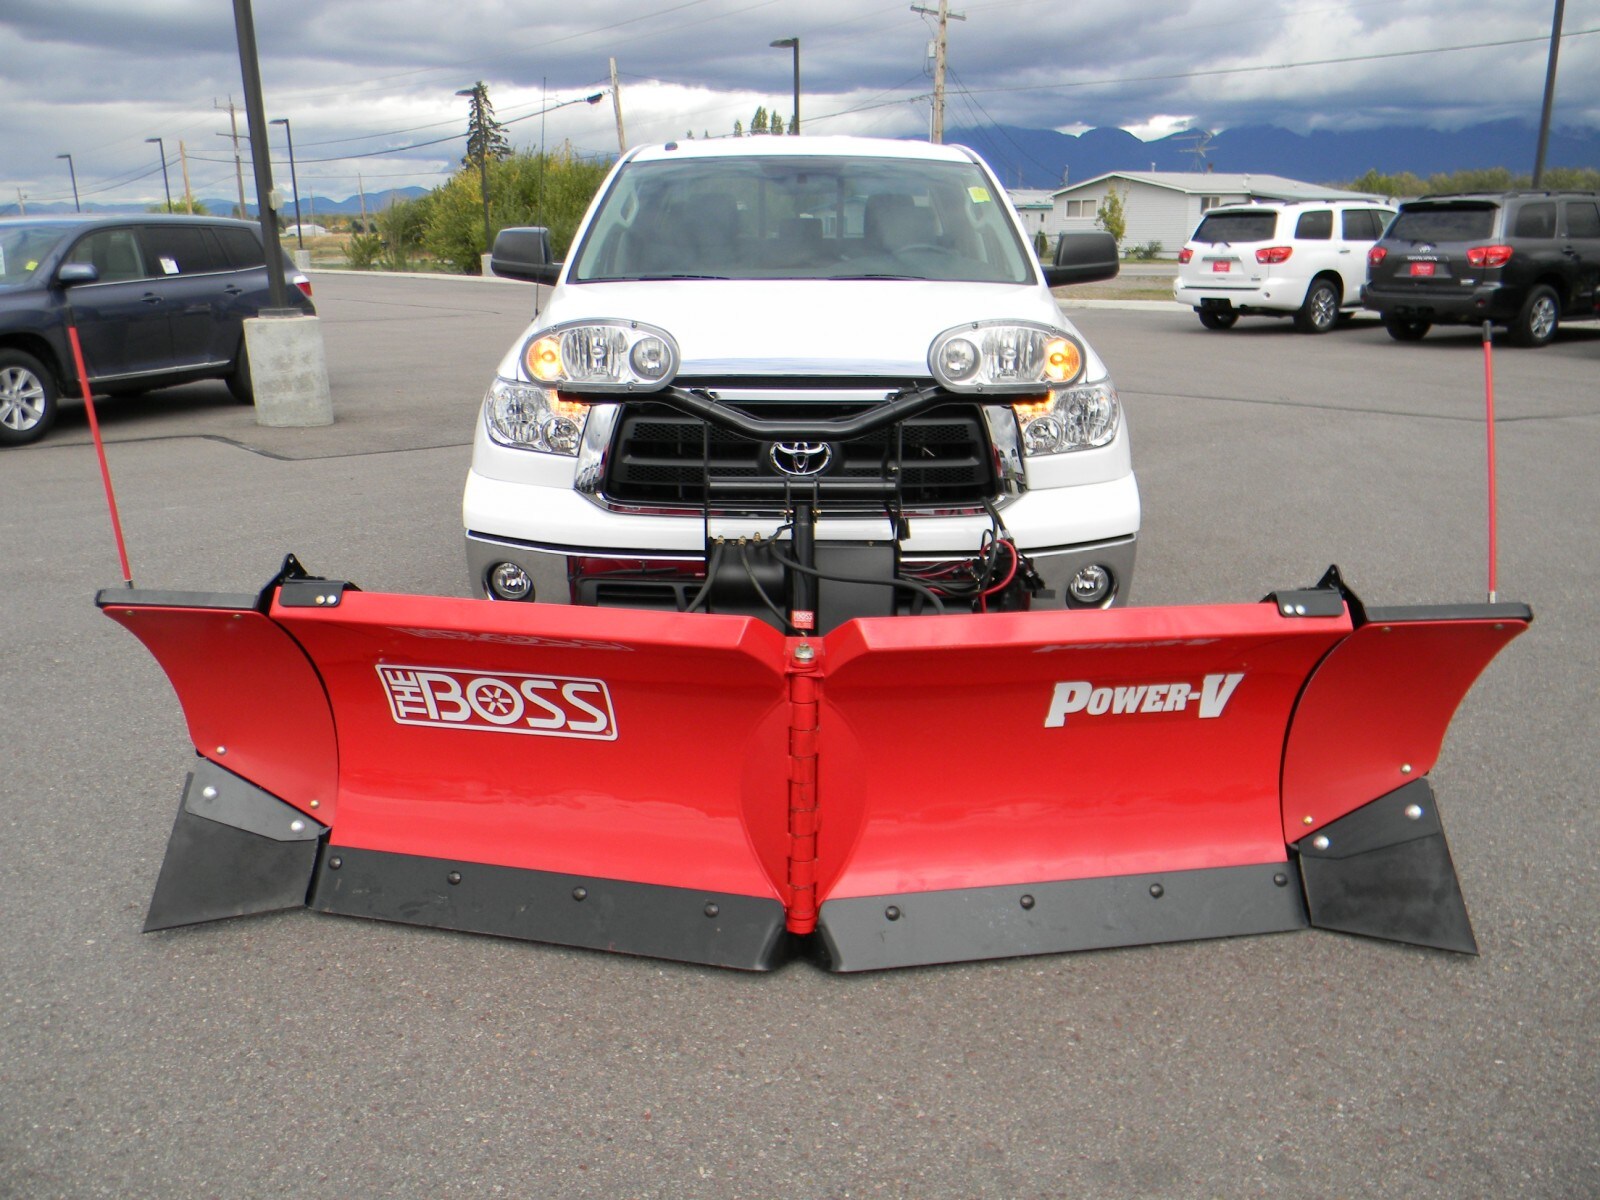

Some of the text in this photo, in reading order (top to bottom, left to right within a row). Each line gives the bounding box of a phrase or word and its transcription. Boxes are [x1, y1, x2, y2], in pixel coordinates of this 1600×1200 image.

[384, 670, 608, 732] THE BOSS
[1044, 673, 1245, 728] POWER-V
